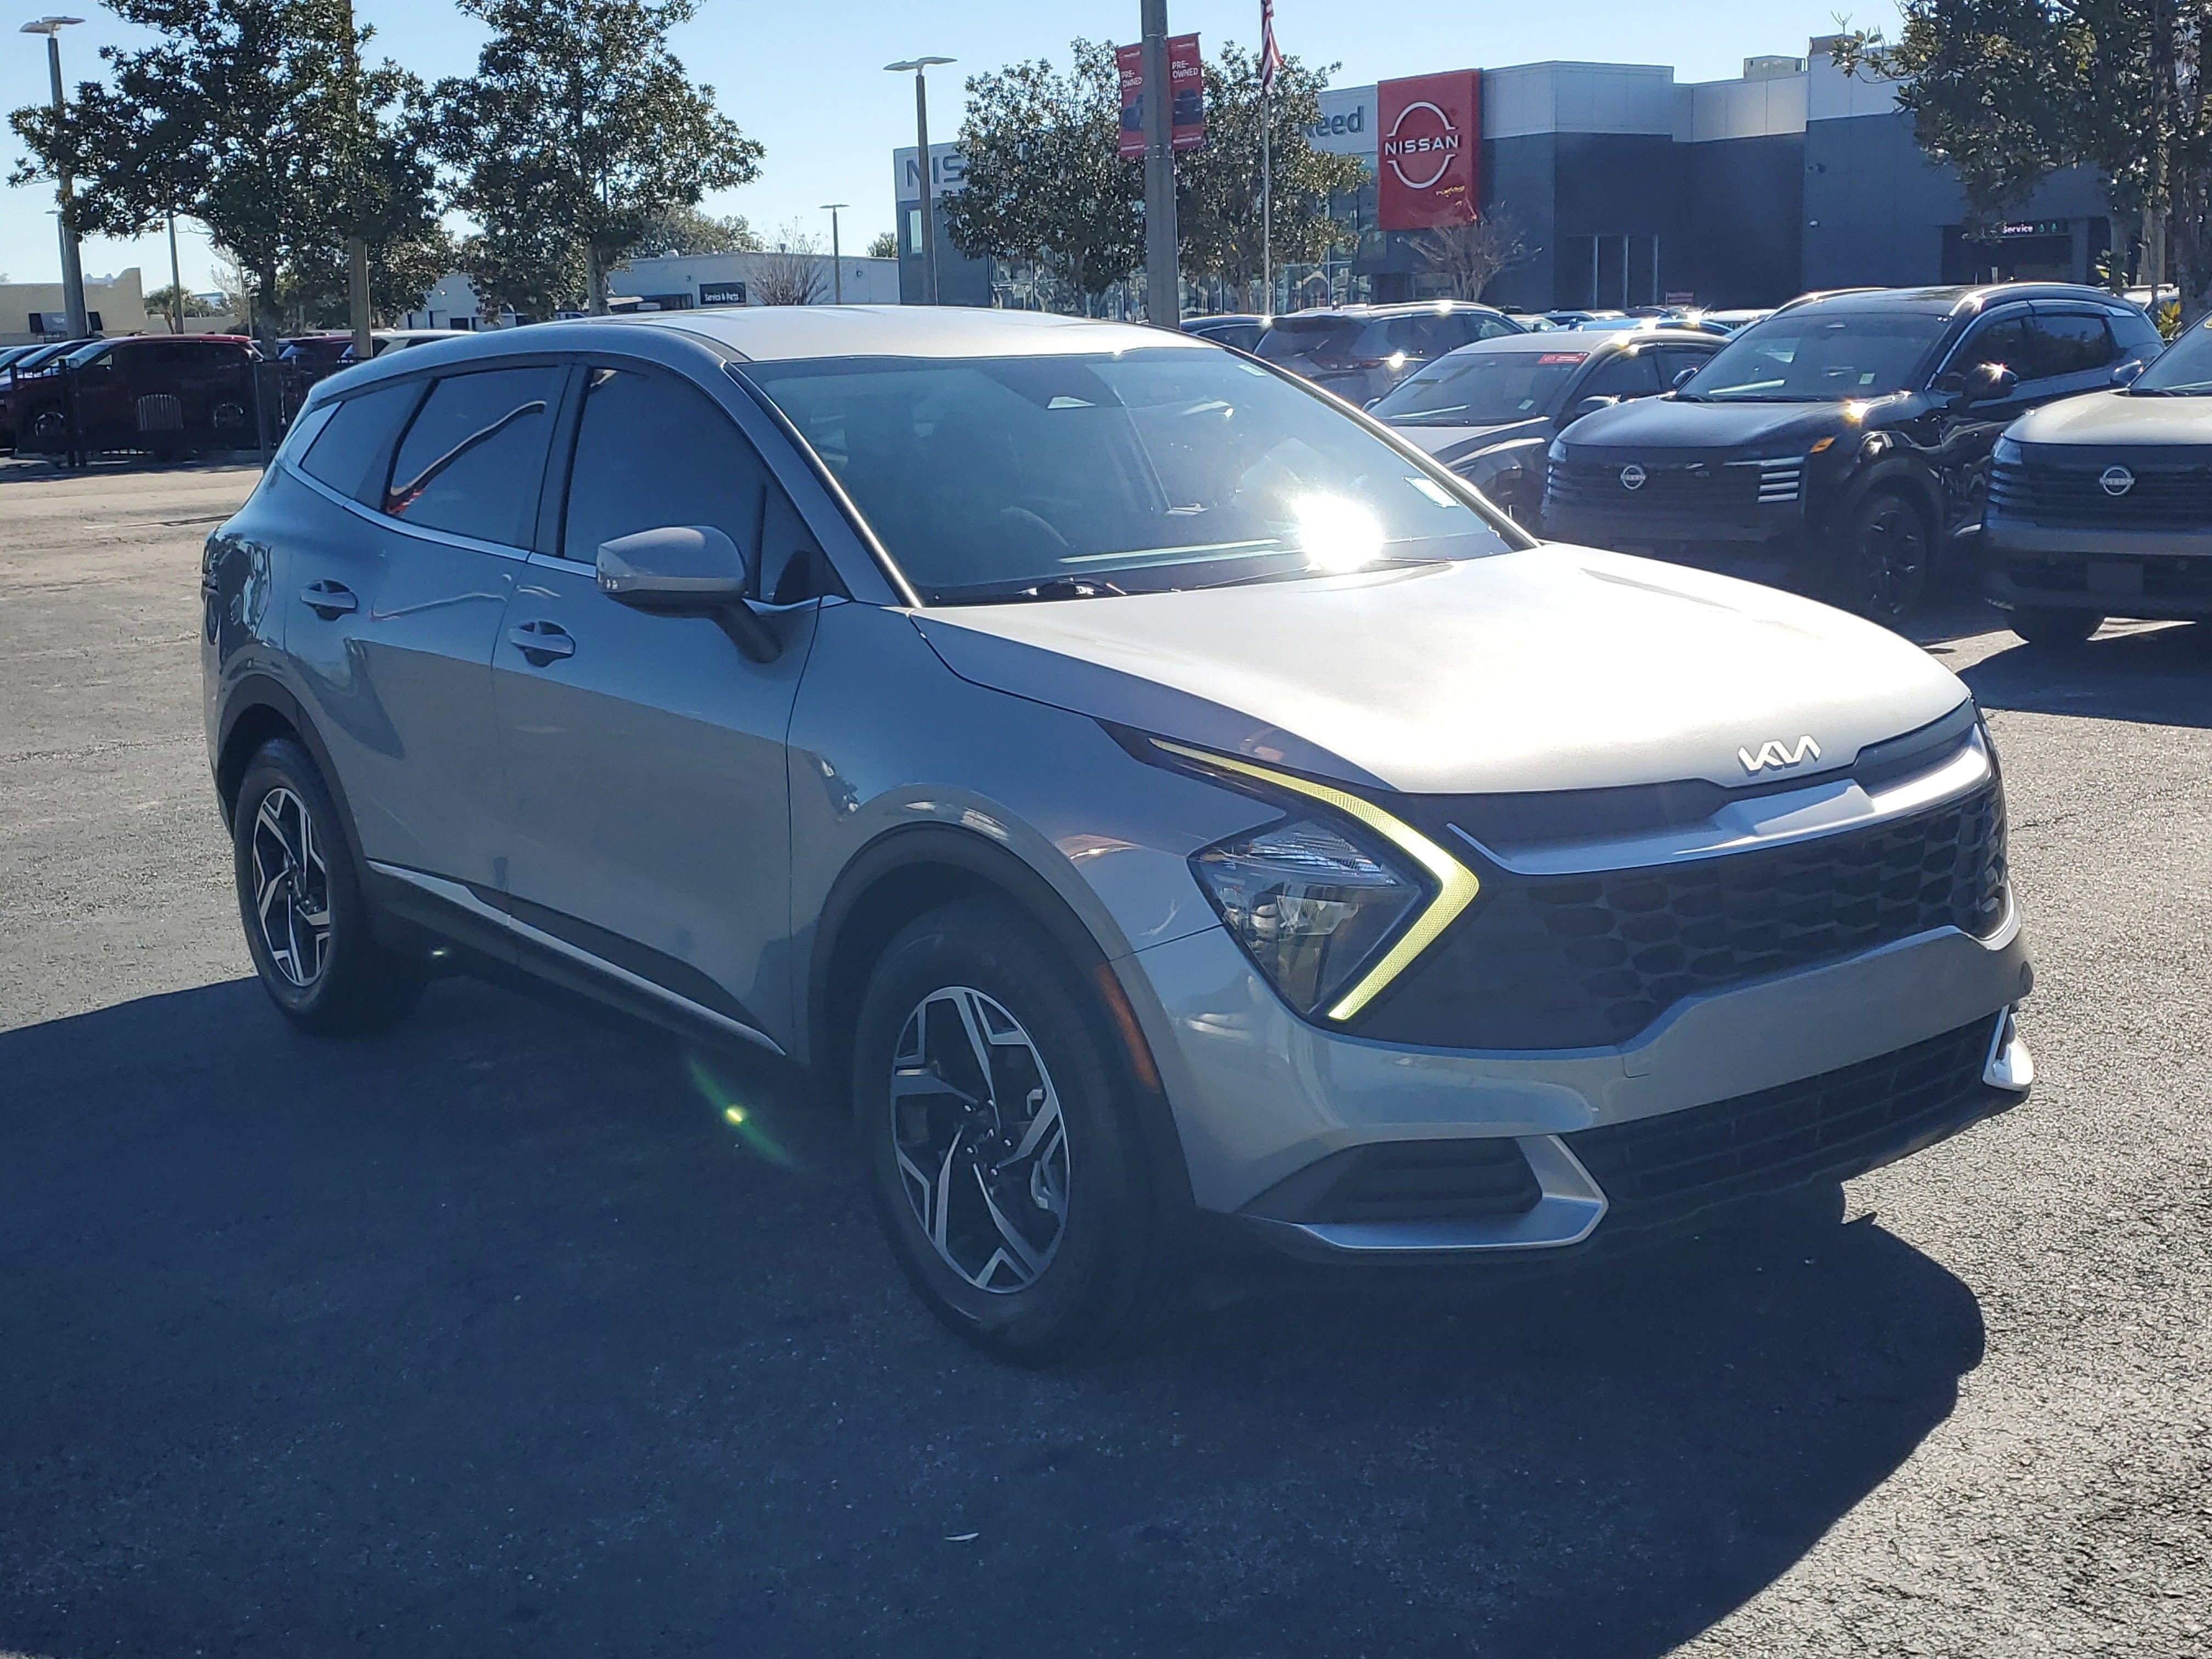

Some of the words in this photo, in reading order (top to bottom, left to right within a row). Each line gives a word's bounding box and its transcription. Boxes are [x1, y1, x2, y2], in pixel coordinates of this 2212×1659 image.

[1172, 61, 1189, 70] PRE-
[1172, 67, 1198, 78] OWNED
[1385, 135, 1458, 156] NISSAN
[2003, 223, 2033, 234] Service
